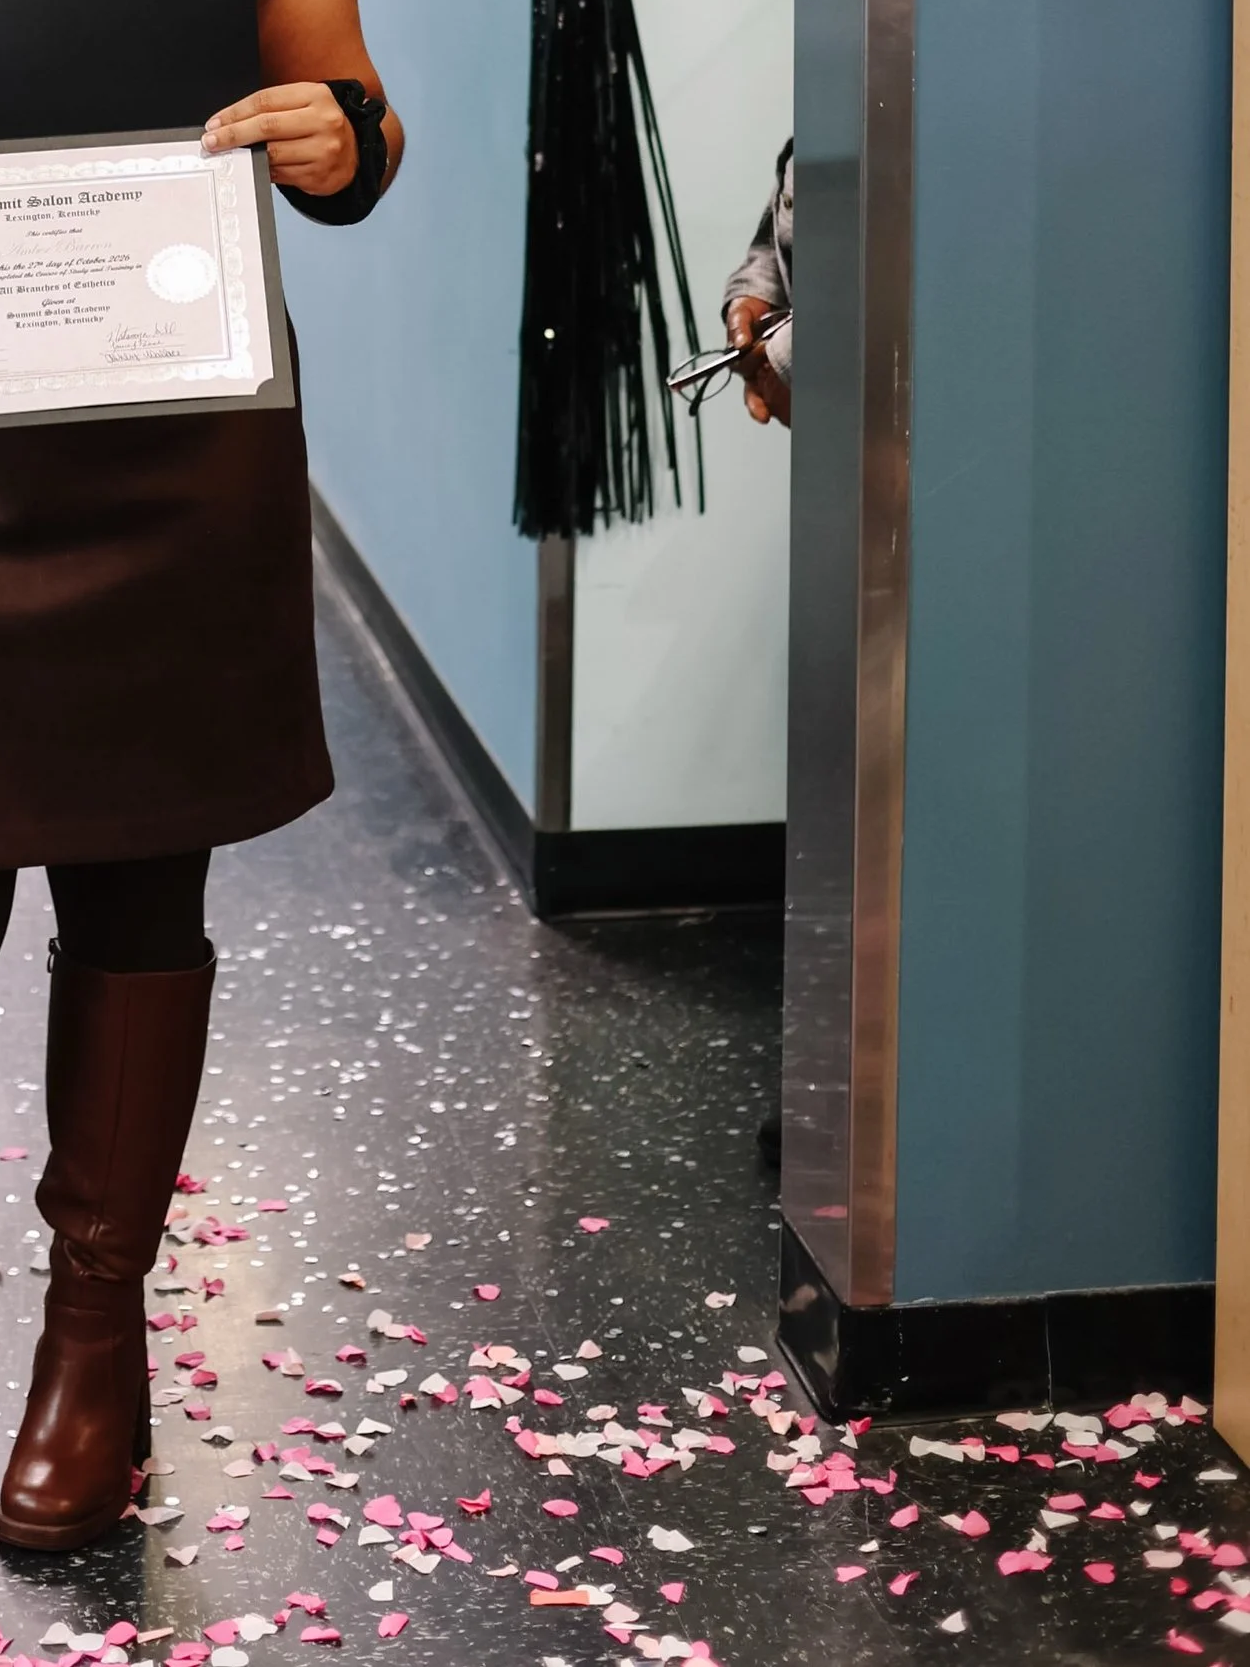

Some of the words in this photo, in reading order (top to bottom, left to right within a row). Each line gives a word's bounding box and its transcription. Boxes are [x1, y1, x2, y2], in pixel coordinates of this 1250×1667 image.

[26, 194, 73, 208] Salon
[78, 190, 143, 204] Academy
[4, 212, 54, 222] Lexington,
[58, 208, 101, 219] Kentucky
[13, 262, 26, 271] the
[45, 260, 62, 269] day
[64, 259, 74, 267] of
[76, 256, 106, 265] October
[35, 270, 58, 278] Course
[59, 269, 68, 277] of
[16, 283, 60, 294] Branches
[62, 282, 71, 290] of
[73, 279, 116, 289] Esthetics
[41, 298, 64, 307] Given
[65, 297, 76, 305] at
[6, 310, 42, 320] Summit
[44, 308, 71, 317] Salon
[73, 305, 111, 314] Academy
[15, 319, 61, 330] Lexington,
[64, 316, 104, 325] Kentucky
